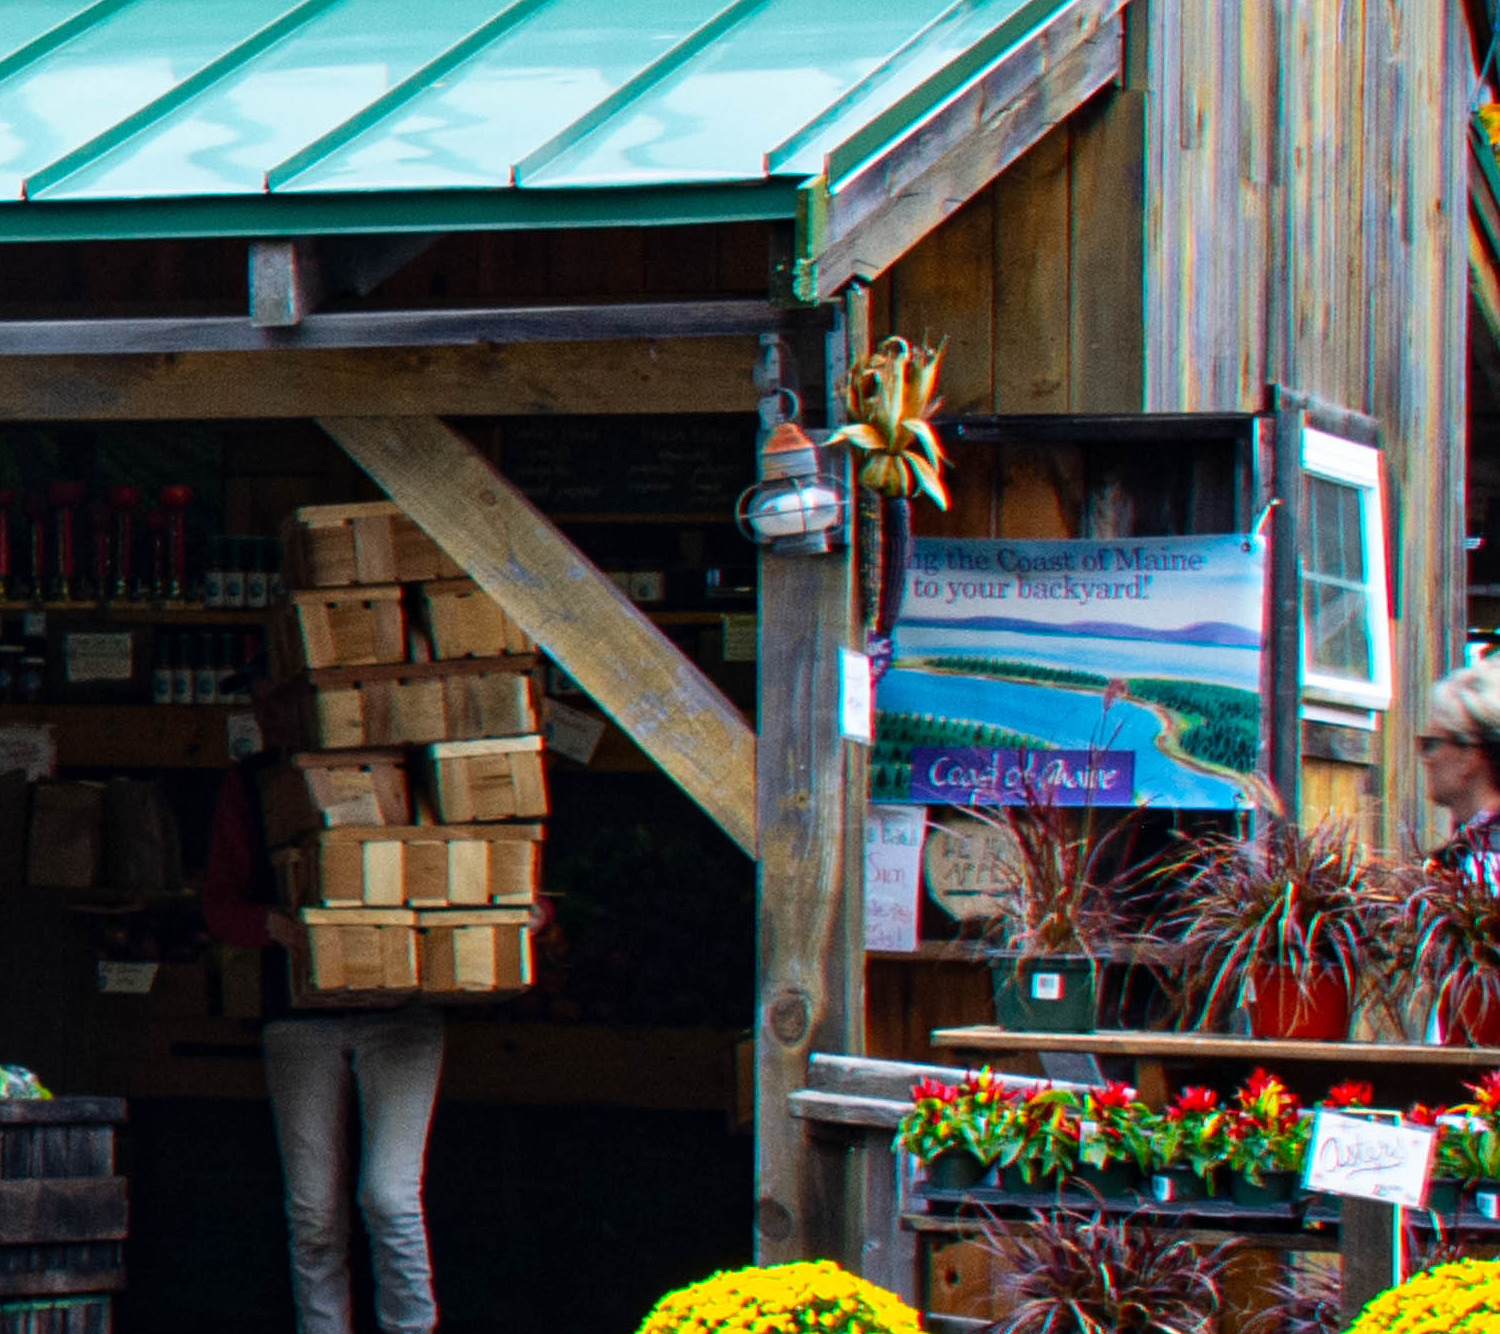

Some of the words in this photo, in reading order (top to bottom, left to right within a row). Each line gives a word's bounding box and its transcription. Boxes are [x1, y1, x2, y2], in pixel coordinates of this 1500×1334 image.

[945, 546, 989, 571] the
[995, 547, 1071, 572] Coast
[1079, 546, 1110, 572] of
[1113, 546, 1204, 572] Maine
[911, 578, 939, 599] to
[946, 581, 1008, 605] your
[1013, 574, 1152, 605] backyard!
